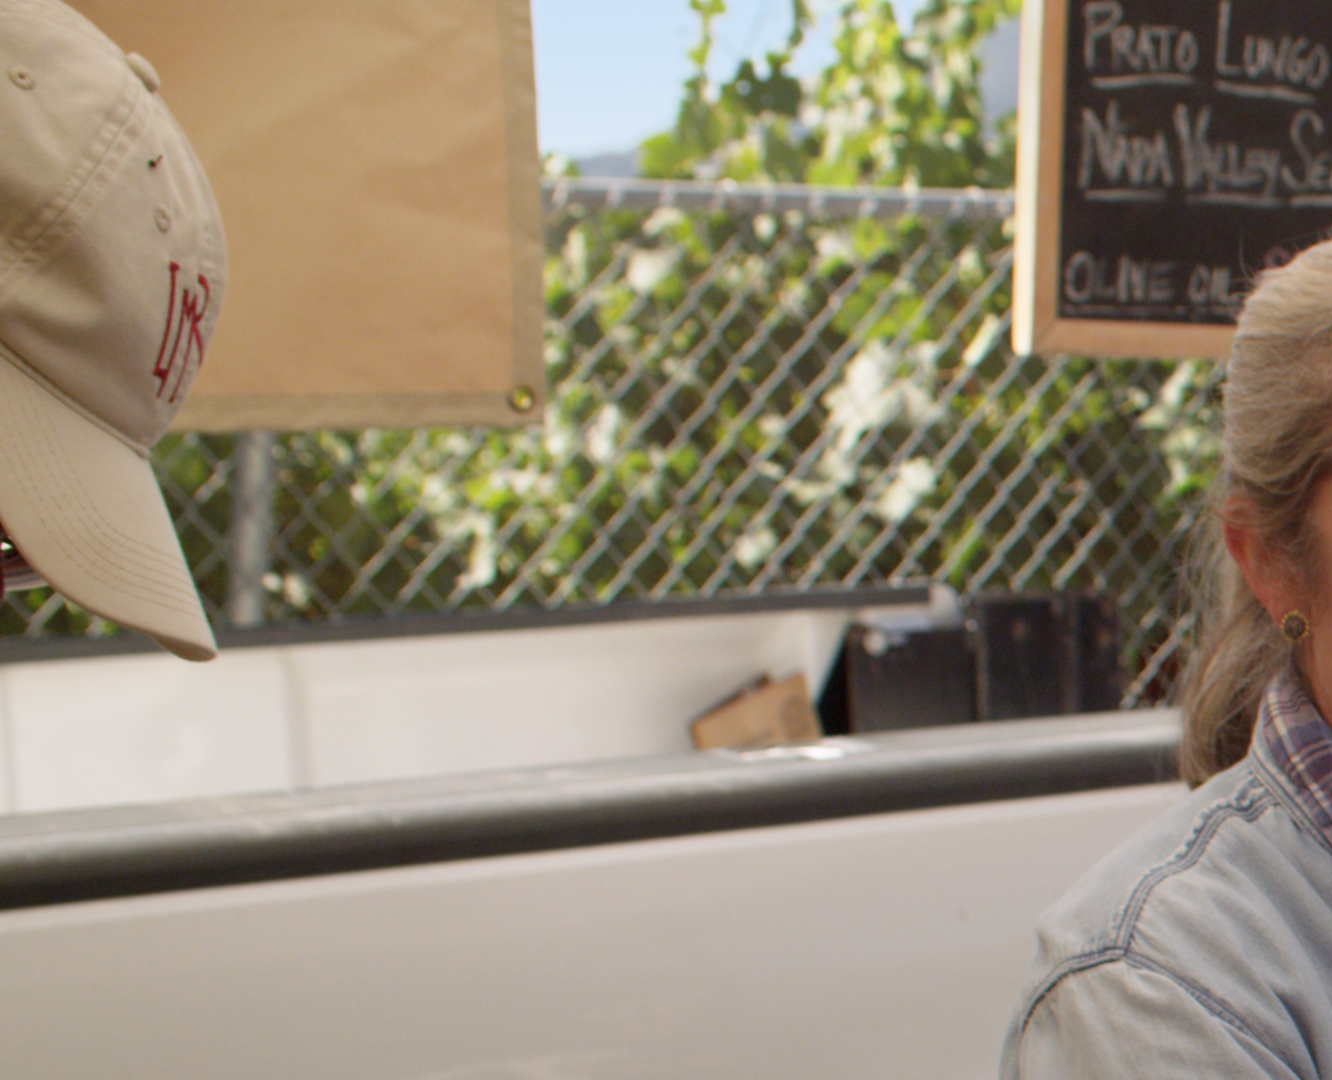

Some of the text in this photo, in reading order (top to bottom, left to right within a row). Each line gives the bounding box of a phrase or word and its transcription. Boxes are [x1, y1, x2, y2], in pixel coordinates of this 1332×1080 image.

[1083, 2, 1199, 72] PRATO
[1215, 0, 1330, 89] LUNGO
[1065, 251, 1174, 302] OLIVE
